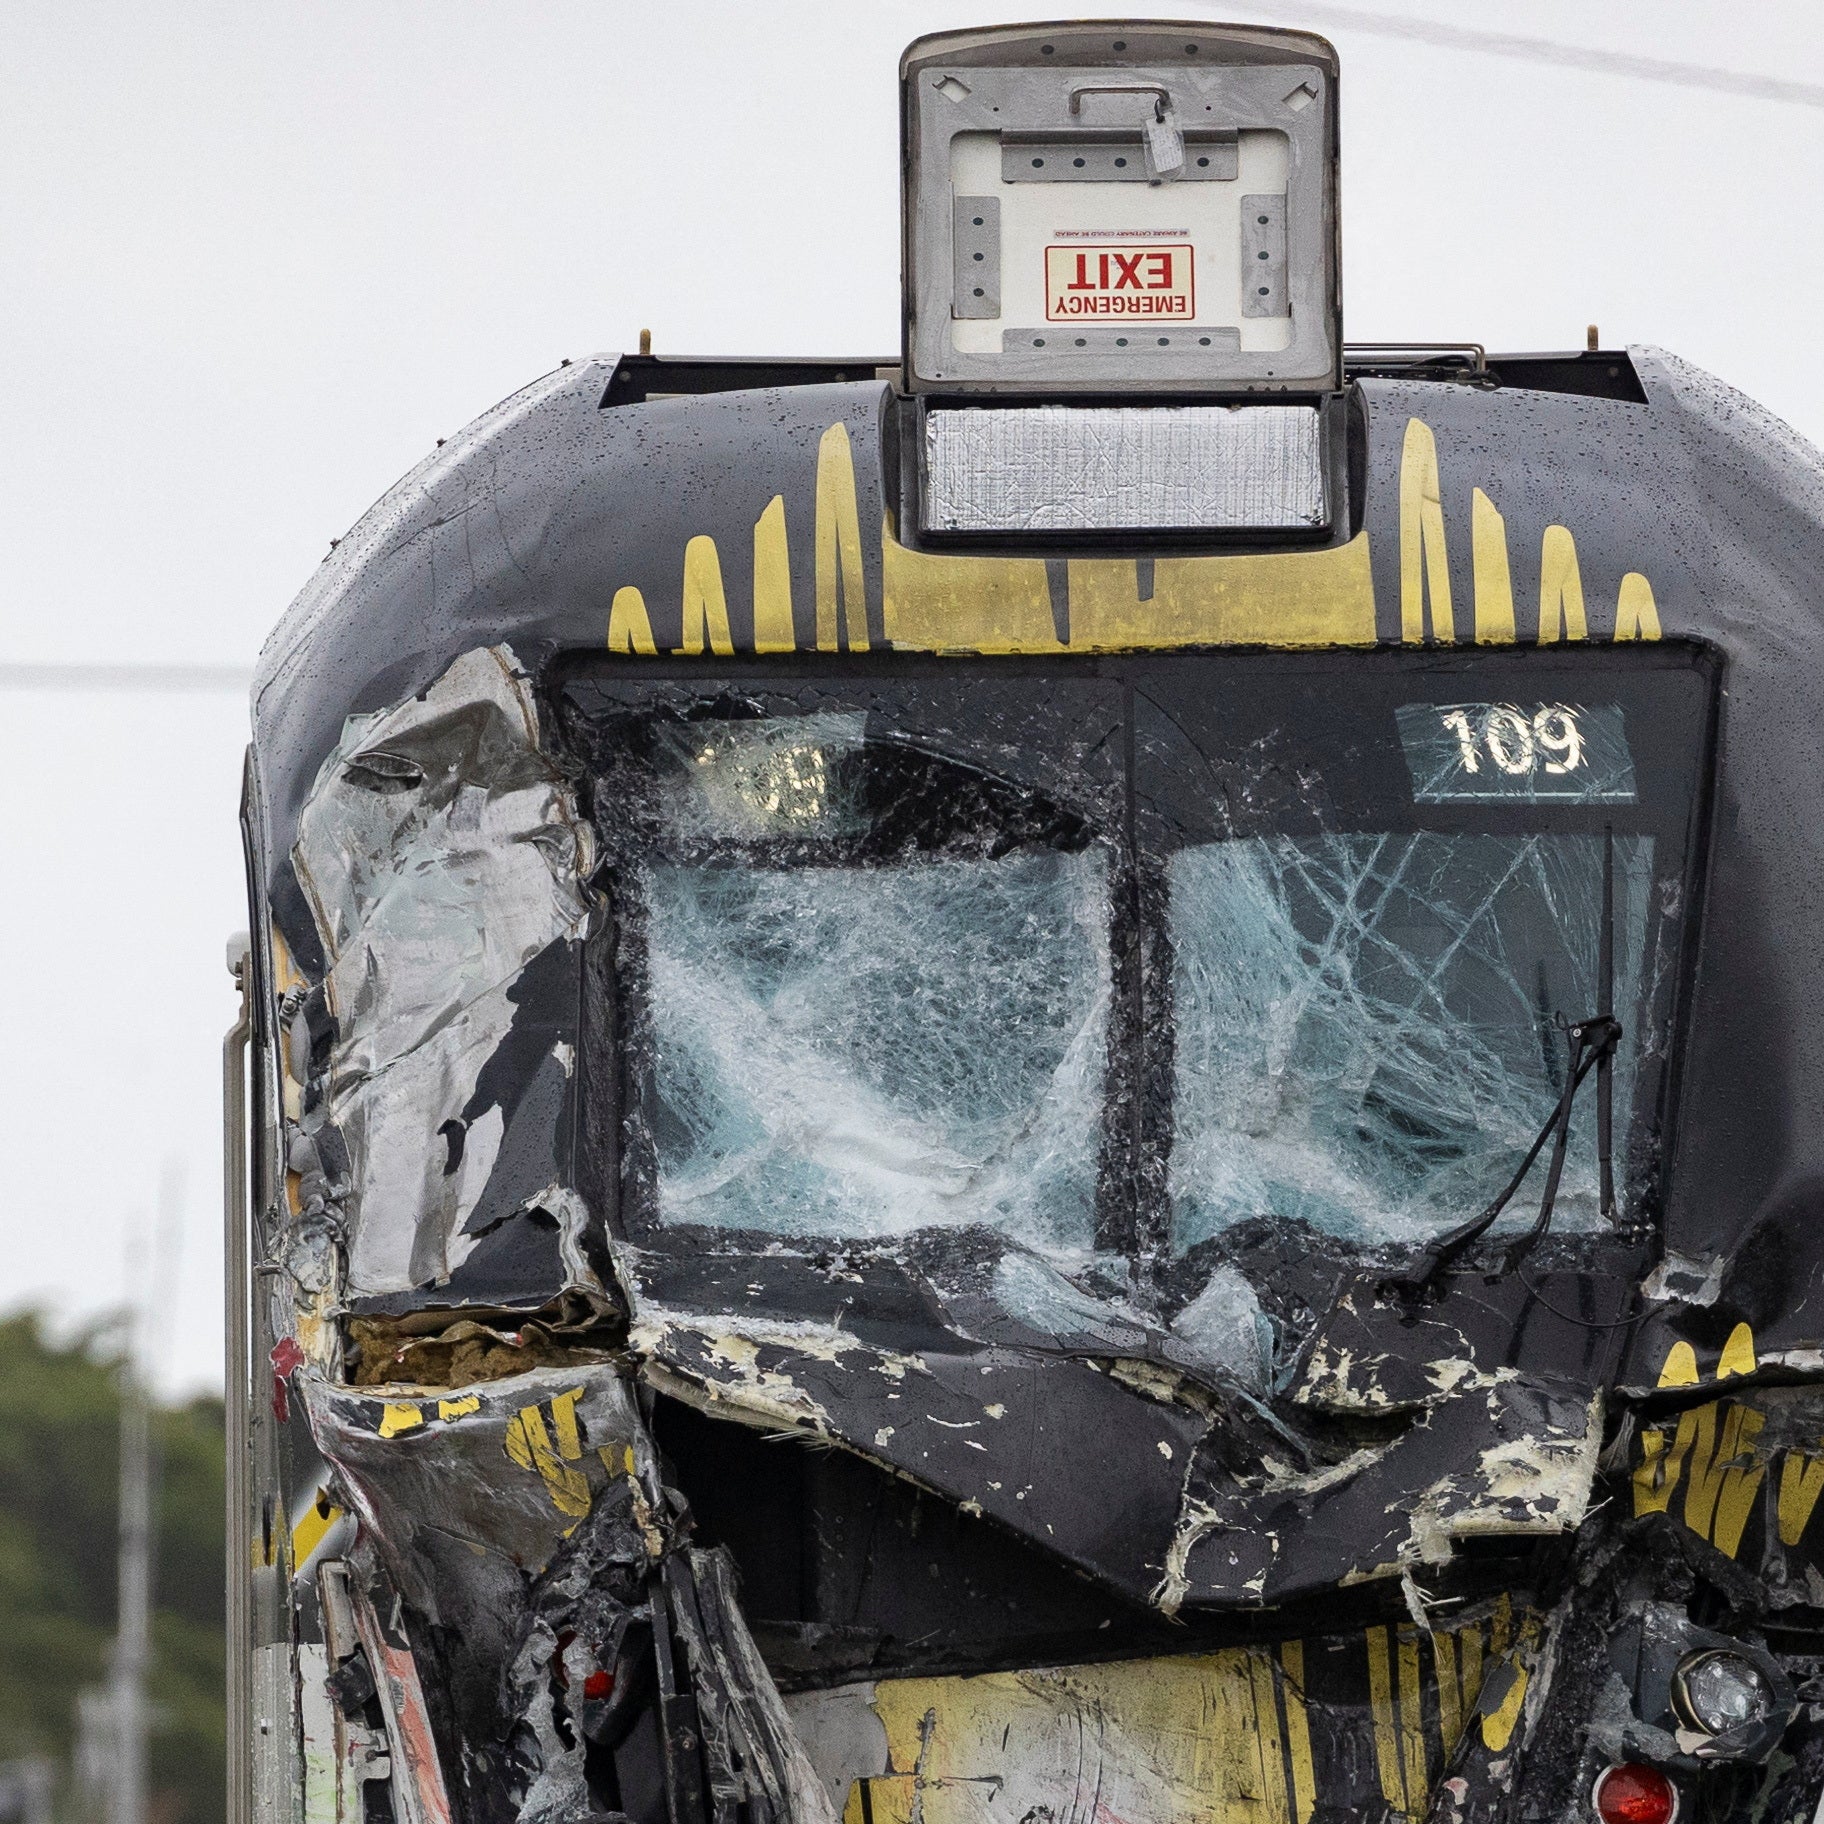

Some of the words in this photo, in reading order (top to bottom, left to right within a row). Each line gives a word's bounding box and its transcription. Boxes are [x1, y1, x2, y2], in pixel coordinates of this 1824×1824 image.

[1067, 253, 1173, 290] EXIT
[1055, 295, 1187, 314] EMERGENCY
[1442, 705, 1581, 775] 109
